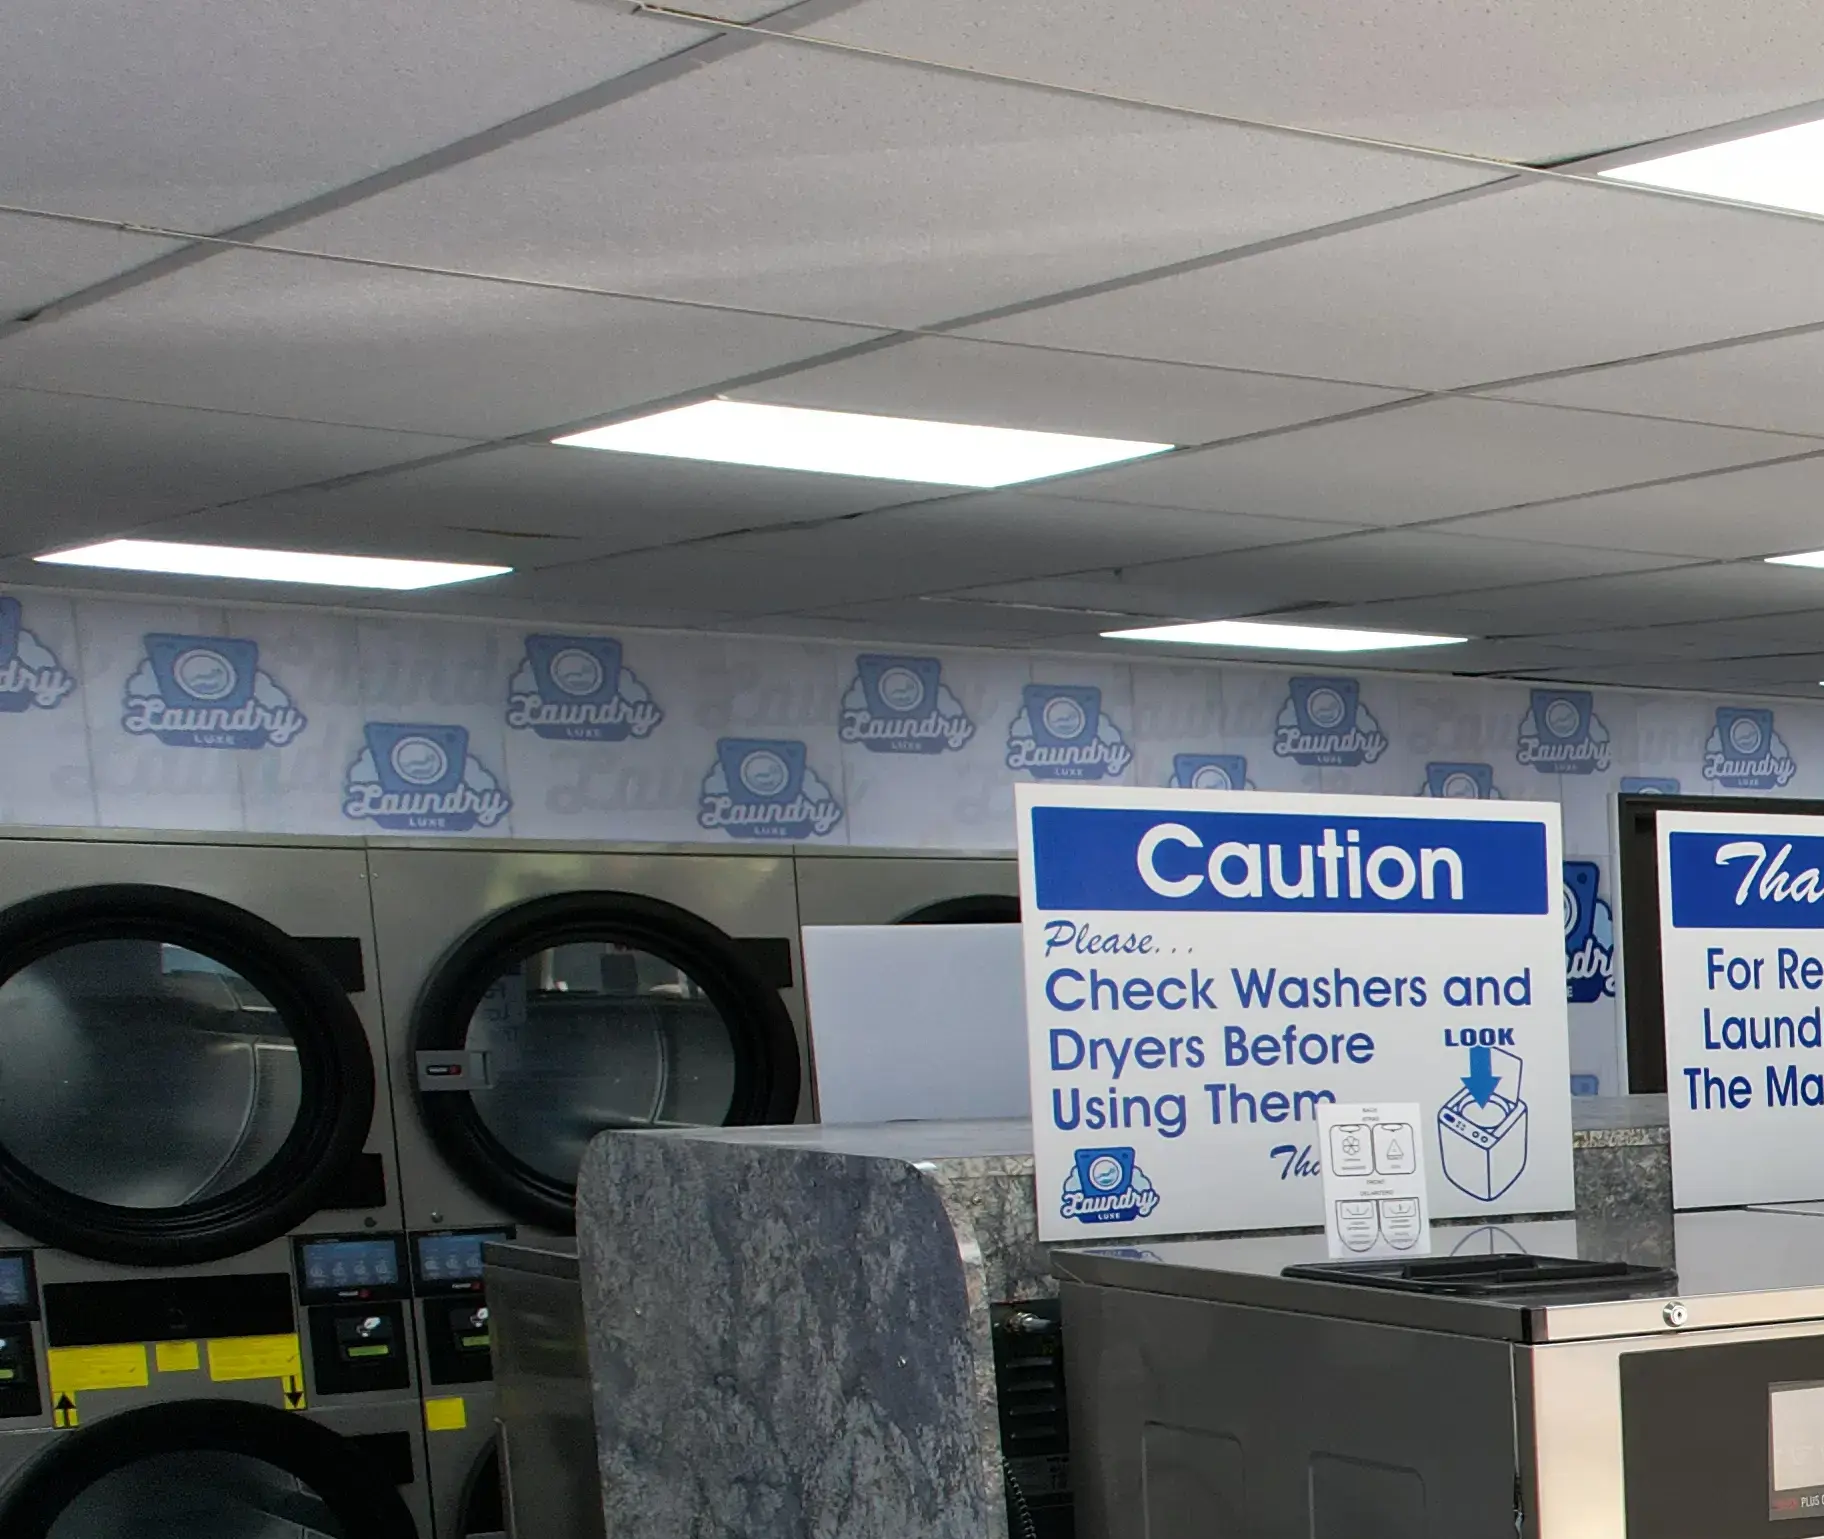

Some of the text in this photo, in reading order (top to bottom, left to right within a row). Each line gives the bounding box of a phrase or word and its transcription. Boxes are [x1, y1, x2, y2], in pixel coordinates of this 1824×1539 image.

[126, 699, 301, 743] Laundry
[509, 694, 660, 735] Laundry
[842, 711, 972, 747] Laundry
[1008, 736, 1130, 774] Laundry
[1276, 725, 1386, 761] Laundry
[1705, 752, 1795, 784] Laundry
[348, 784, 508, 825] Laundry
[409, 817, 445, 828] LUXE
[702, 796, 841, 834] Laundry
[1136, 823, 1464, 900] Caution
[1706, 947, 1765, 991] For
[1045, 968, 1532, 1011] Check Washers and
[1049, 1026, 1375, 1079] Dryers Before
[1444, 1028, 1515, 1047] LOOK
[1683, 1065, 1752, 1110] The
[1052, 1086, 1187, 1138] Using
[1062, 1187, 1158, 1216] Laundry
[1801, 1494, 1820, 1507] PLUS
